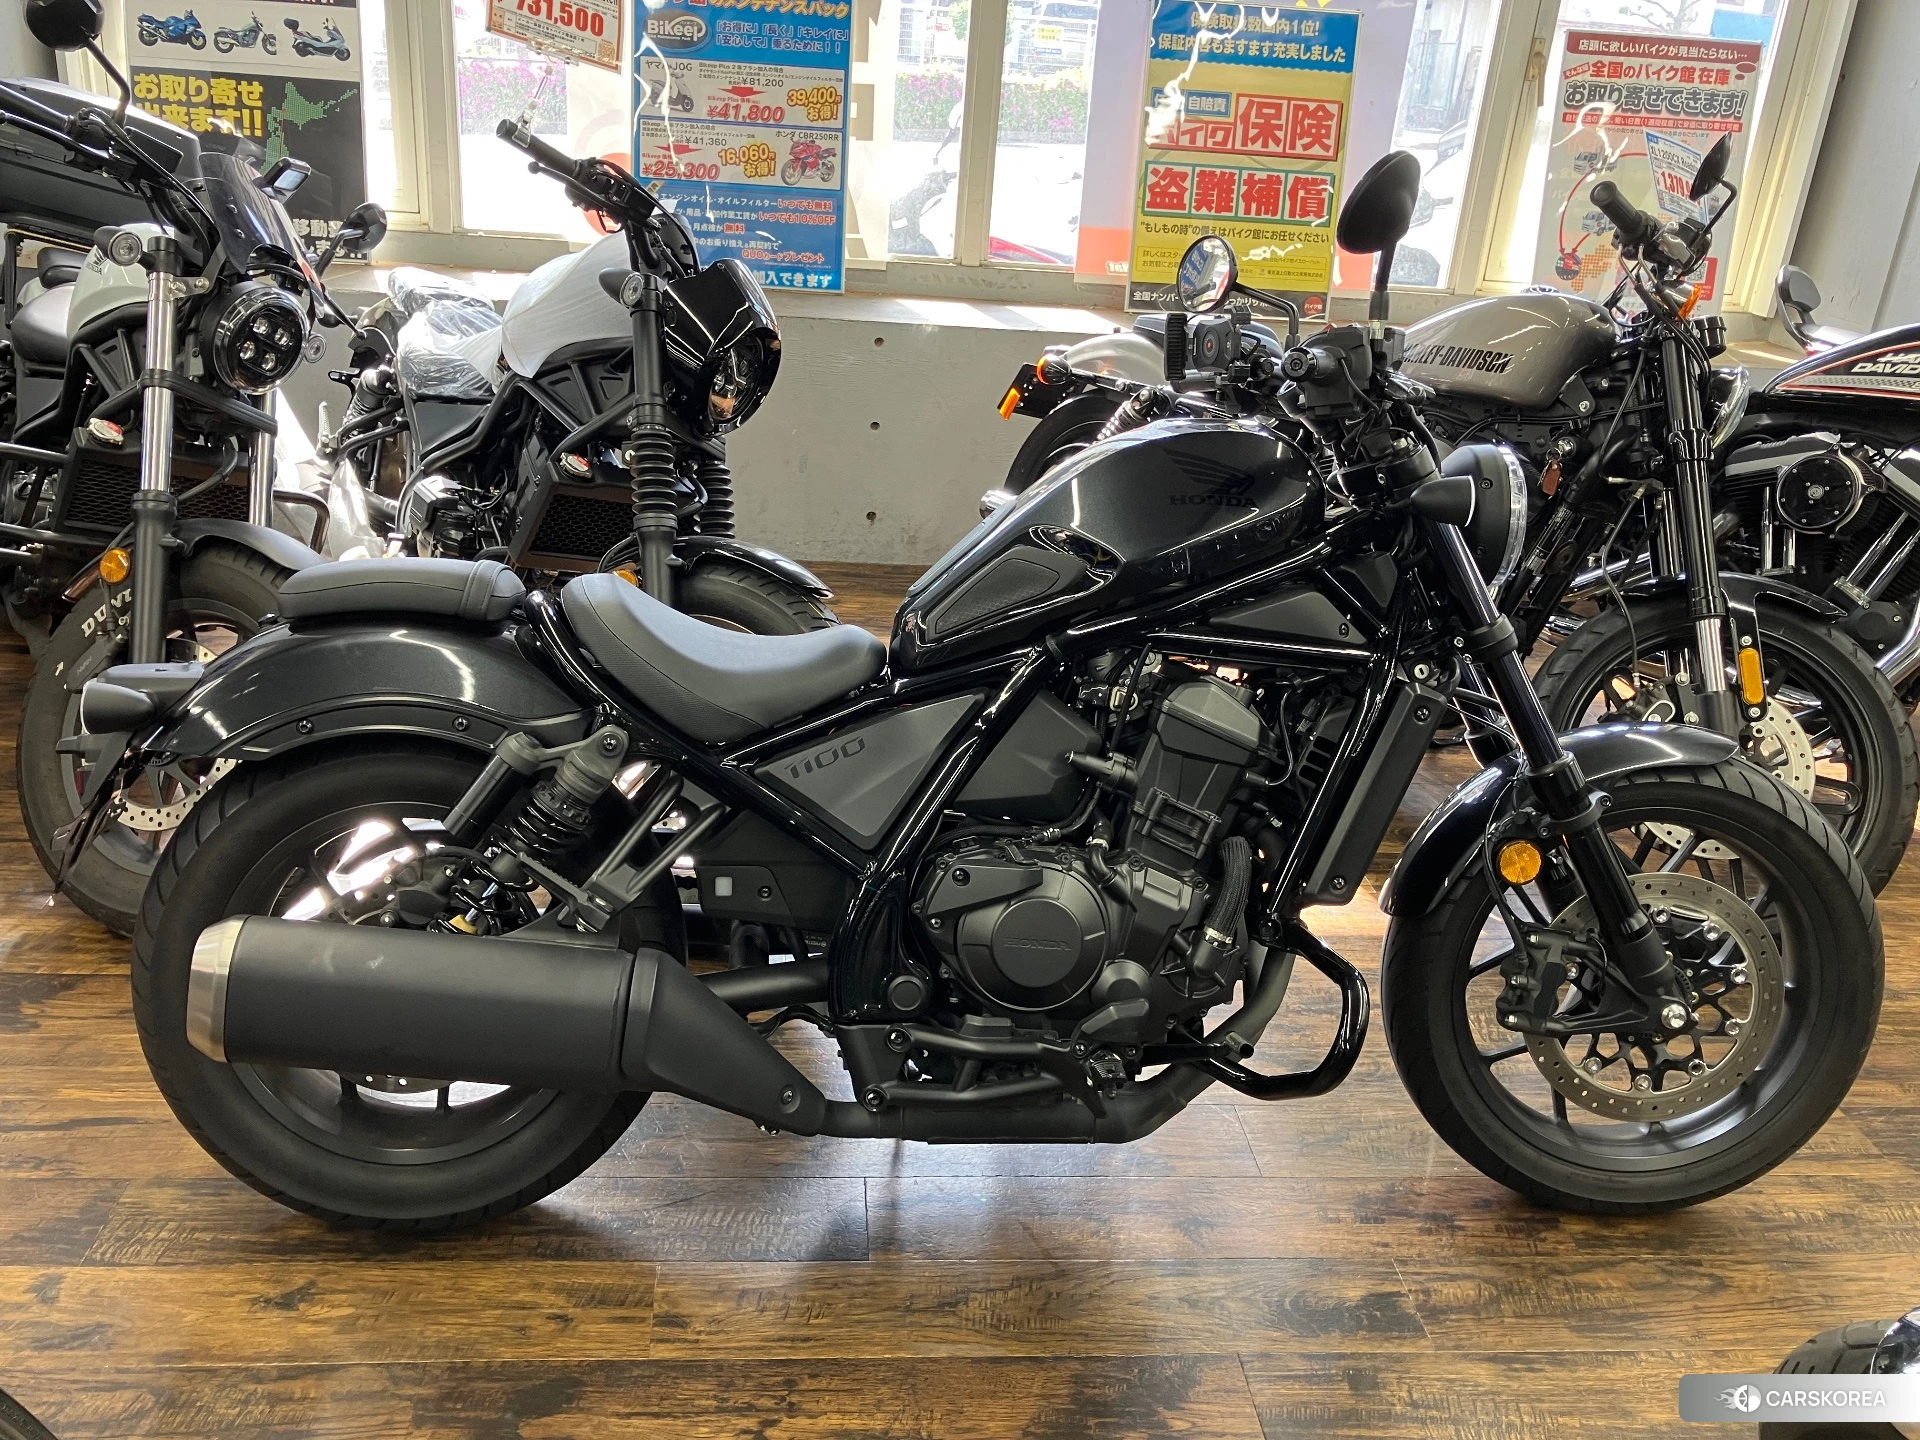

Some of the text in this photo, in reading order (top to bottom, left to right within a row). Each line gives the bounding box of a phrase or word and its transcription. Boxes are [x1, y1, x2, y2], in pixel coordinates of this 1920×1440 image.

[673, 62, 693, 72] JOG
[133, 72, 264, 107] お取り寄せ
[786, 86, 842, 106] 39,400円
[1564, 80, 1749, 117] お取り寄せできます!
[707, 103, 785, 123] ¥41,800
[807, 103, 839, 122] お得!
[685, 135, 727, 147] ¥41,360
[775, 130, 839, 141] ホンダ CBR250RR
[718, 143, 776, 166] 16,060円
[642, 160, 720, 181] ¥25,300
[1145, 166, 1329, 219] 盗難補償
[1168, 494, 1258, 508] HONDA
[783, 736, 866, 779] 1100
[1003, 937, 1072, 951] HONDA
